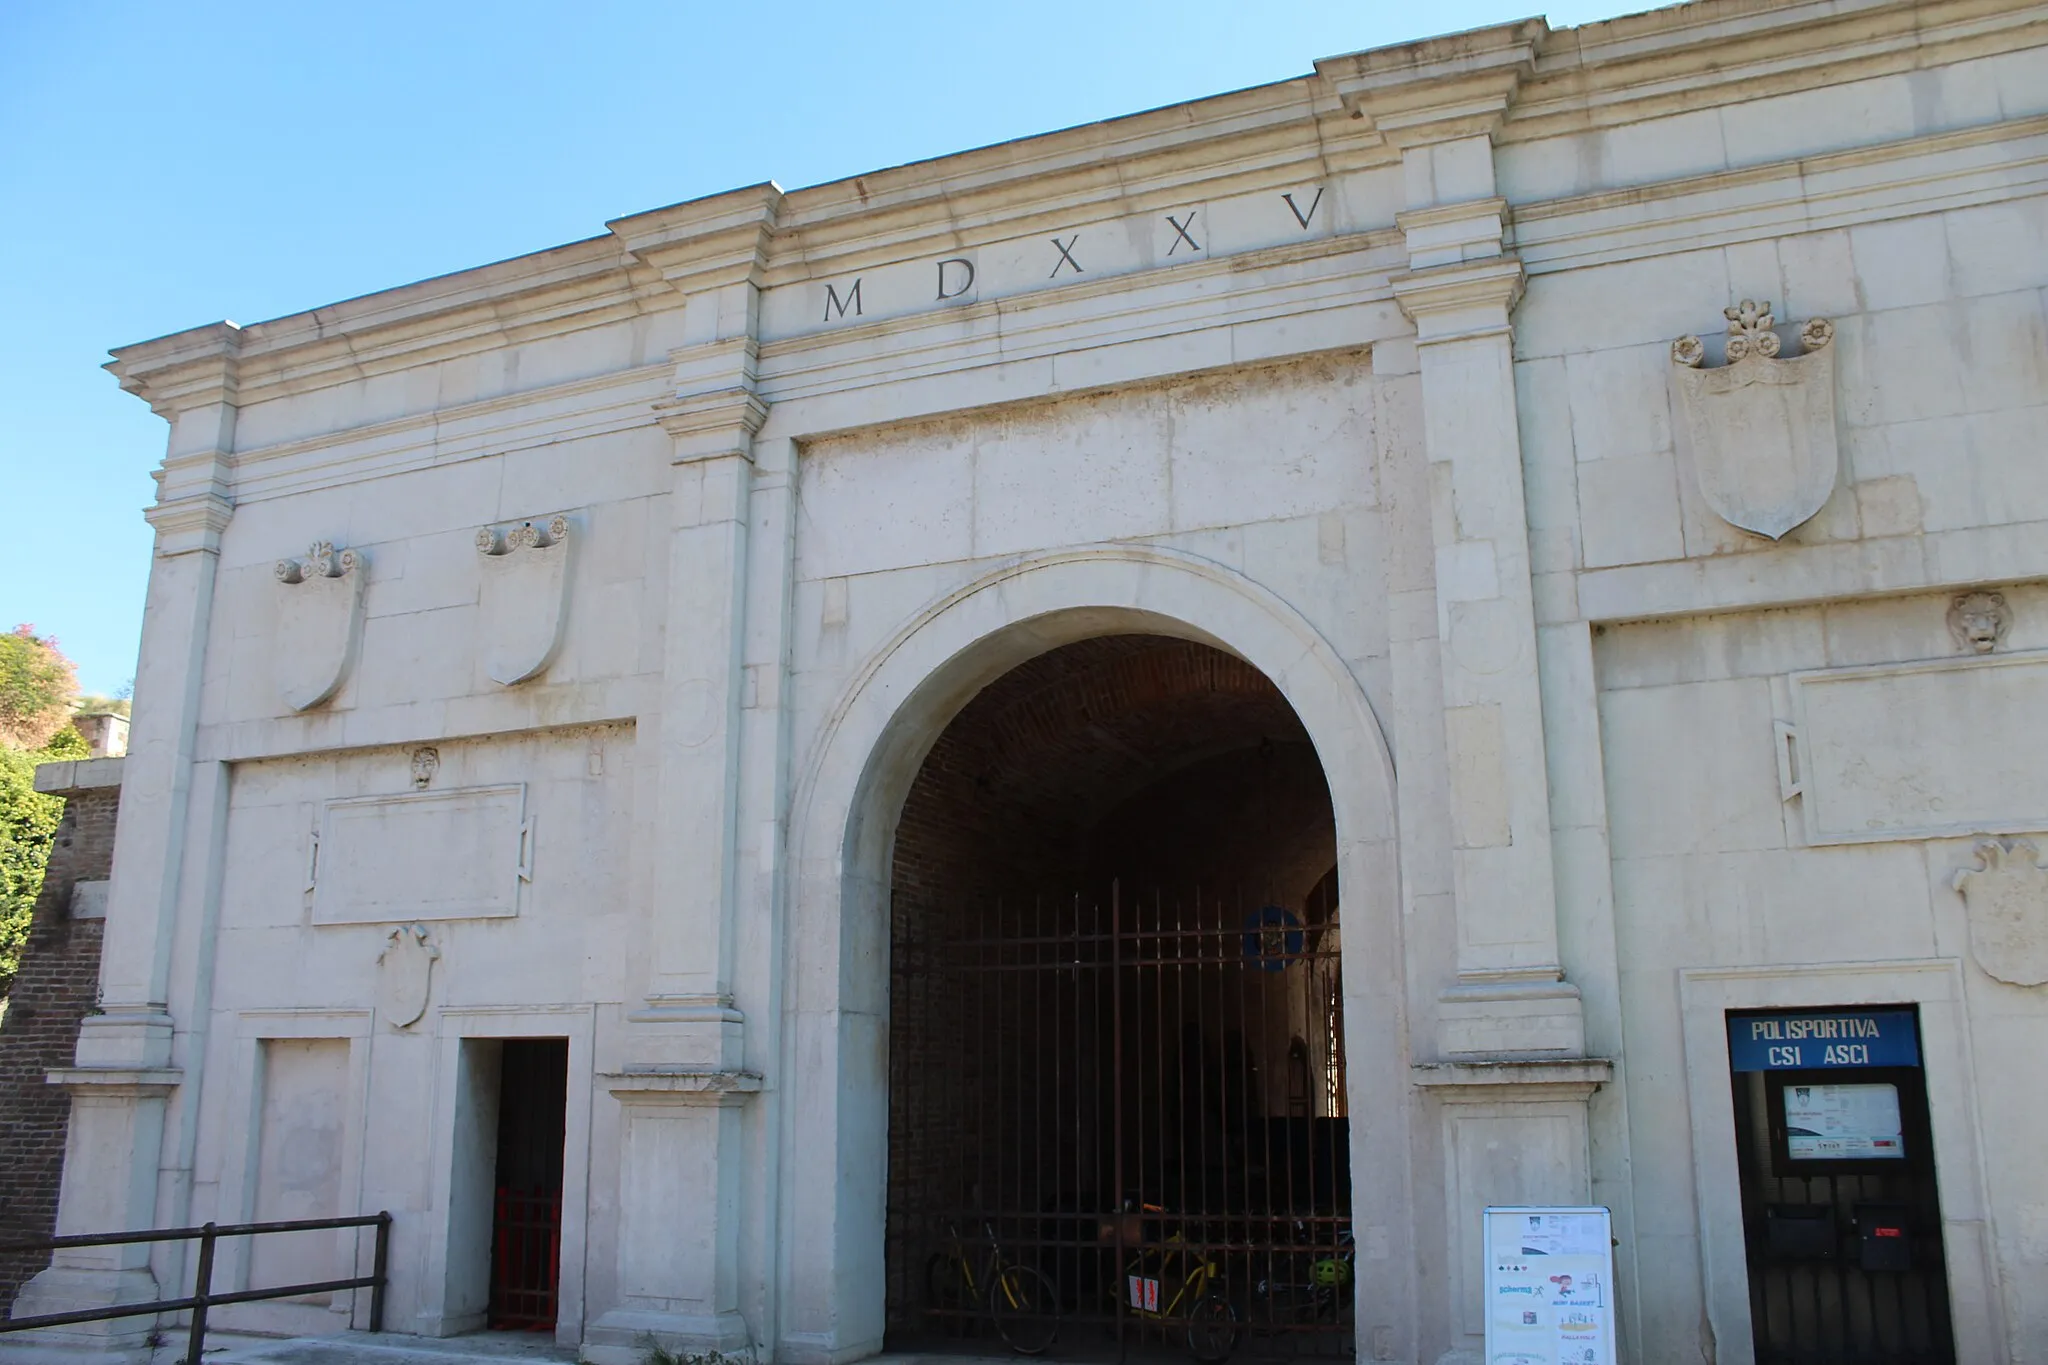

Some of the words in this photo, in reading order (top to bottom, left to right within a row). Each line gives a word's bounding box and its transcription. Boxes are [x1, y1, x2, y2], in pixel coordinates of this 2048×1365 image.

[1751, 1019, 1881, 1040] POLISPORTIVA
[1768, 1046, 1802, 1066] CSI
[1823, 1043, 1869, 1065] ASCI
